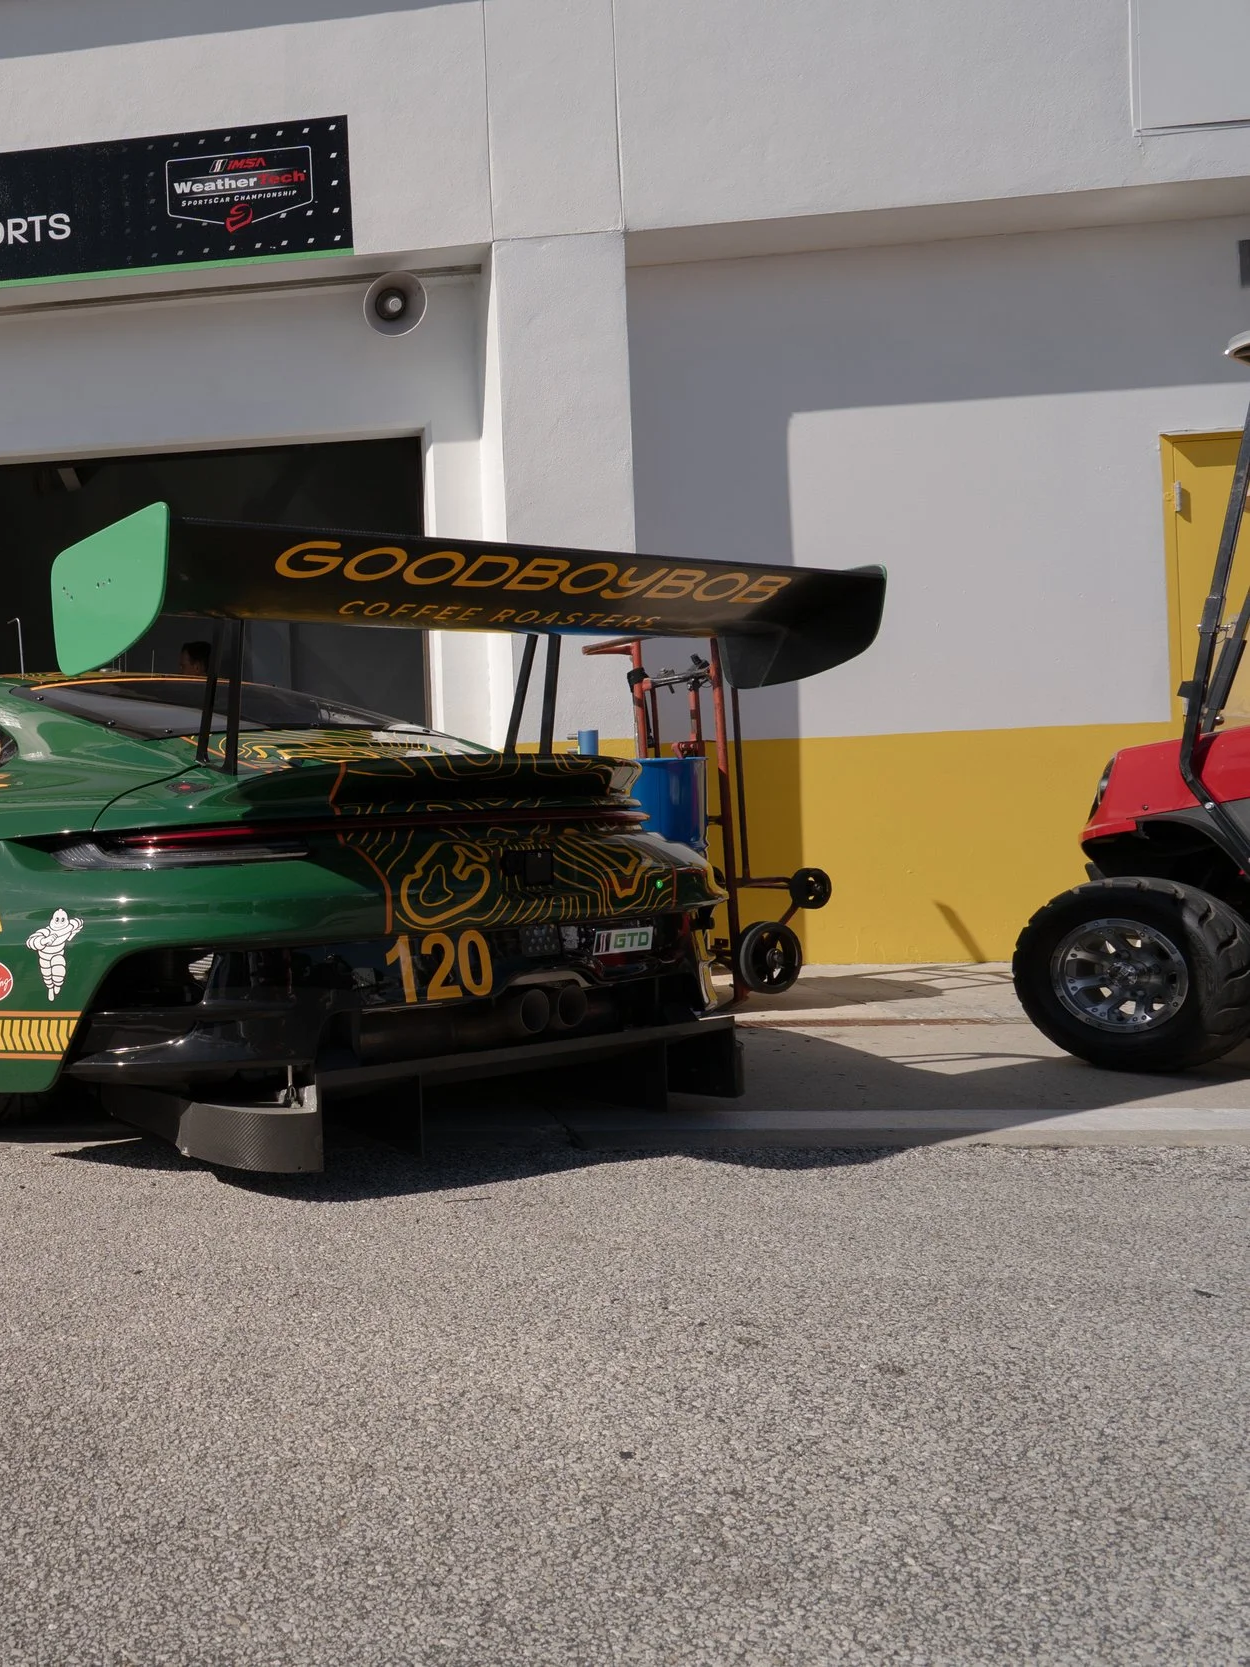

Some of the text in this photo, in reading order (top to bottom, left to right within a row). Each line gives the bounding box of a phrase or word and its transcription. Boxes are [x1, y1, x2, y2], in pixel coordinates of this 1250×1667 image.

[227, 157, 266, 170] IMSA
[173, 170, 306, 194] WeatherTech
[234, 190, 297, 202] CHAMPIONSHIP
[275, 540, 792, 603] GOODBOYBOB
[338, 600, 662, 629] COFFEE ROASTERS
[613, 931, 650, 949] GTD
[385, 929, 494, 1004] 120
